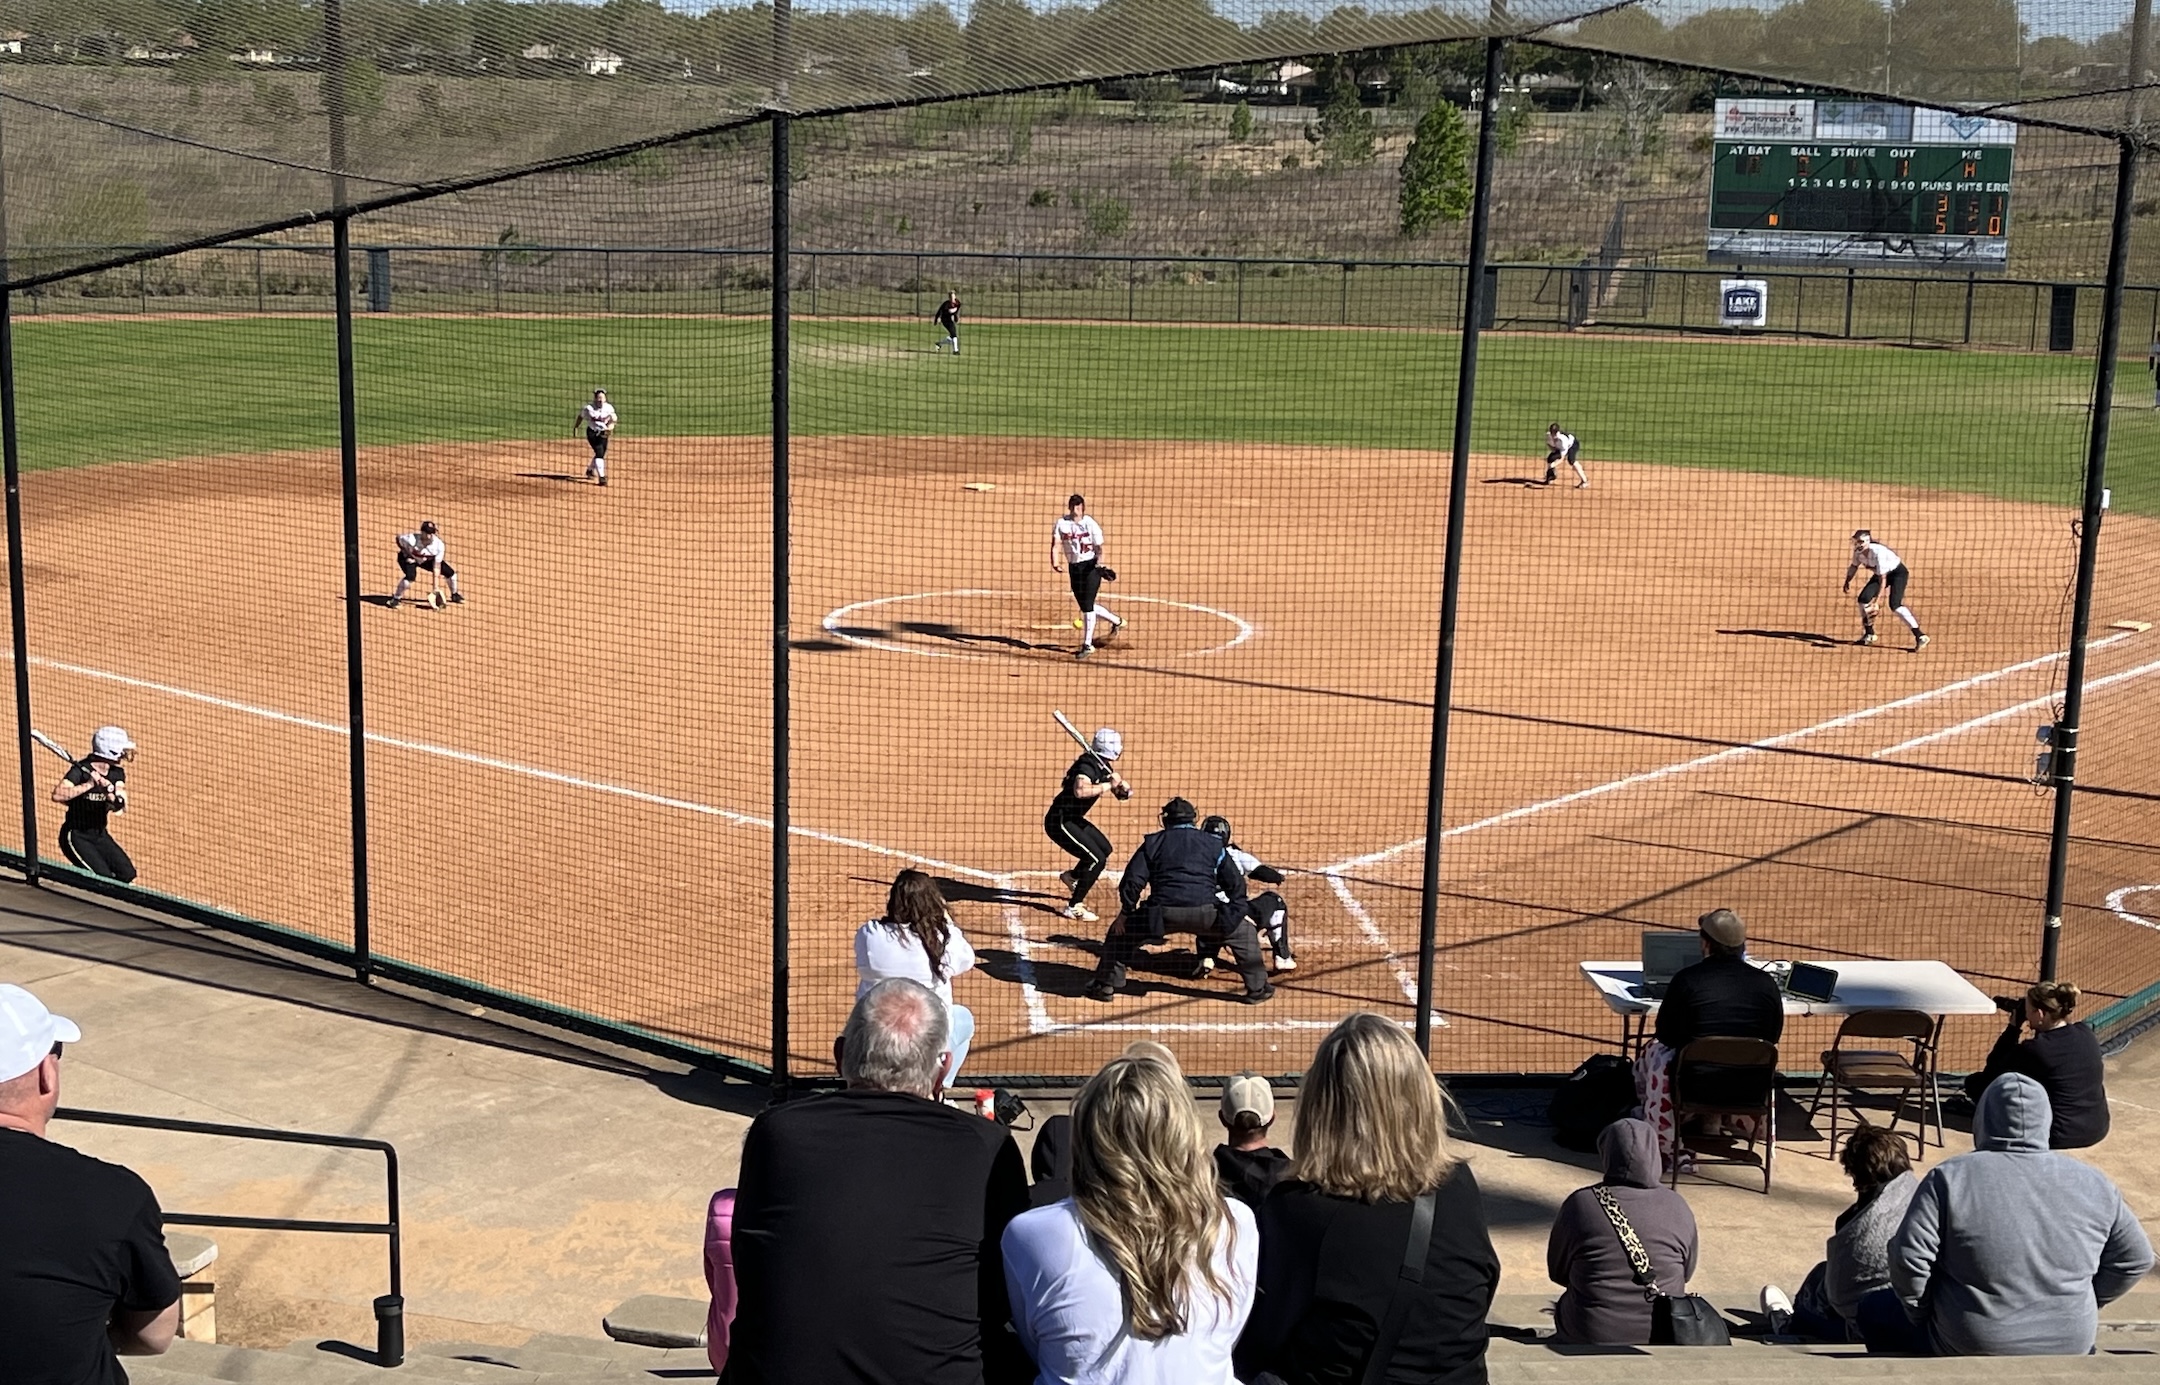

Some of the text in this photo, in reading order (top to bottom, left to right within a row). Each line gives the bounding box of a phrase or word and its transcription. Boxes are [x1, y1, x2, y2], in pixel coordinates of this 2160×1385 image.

[1729, 145, 1771, 155] AT BAT
[1790, 147, 1821, 156] BALL
[1830, 147, 1876, 157] STRIKE
[1889, 149, 1916, 158] OUT
[1788, 178, 1795, 187] 1
[1800, 178, 1808, 187] 2
[1813, 179, 1821, 188] 3
[1826, 179, 1834, 188] 4
[1839, 179, 1847, 189] 5
[1851, 179, 1860, 189] 6
[1865, 180, 1872, 189] 7
[1890, 180, 1898, 190] 9
[1900, 181, 1916, 190] 10
[1920, 181, 1952, 191] RUNS
[1956, 182, 1983, 192] HITS
[1985, 182, 2009, 192] ERR
[1728, 297, 1757, 306] LAKE
[1728, 305, 1756, 313] COUNTY
